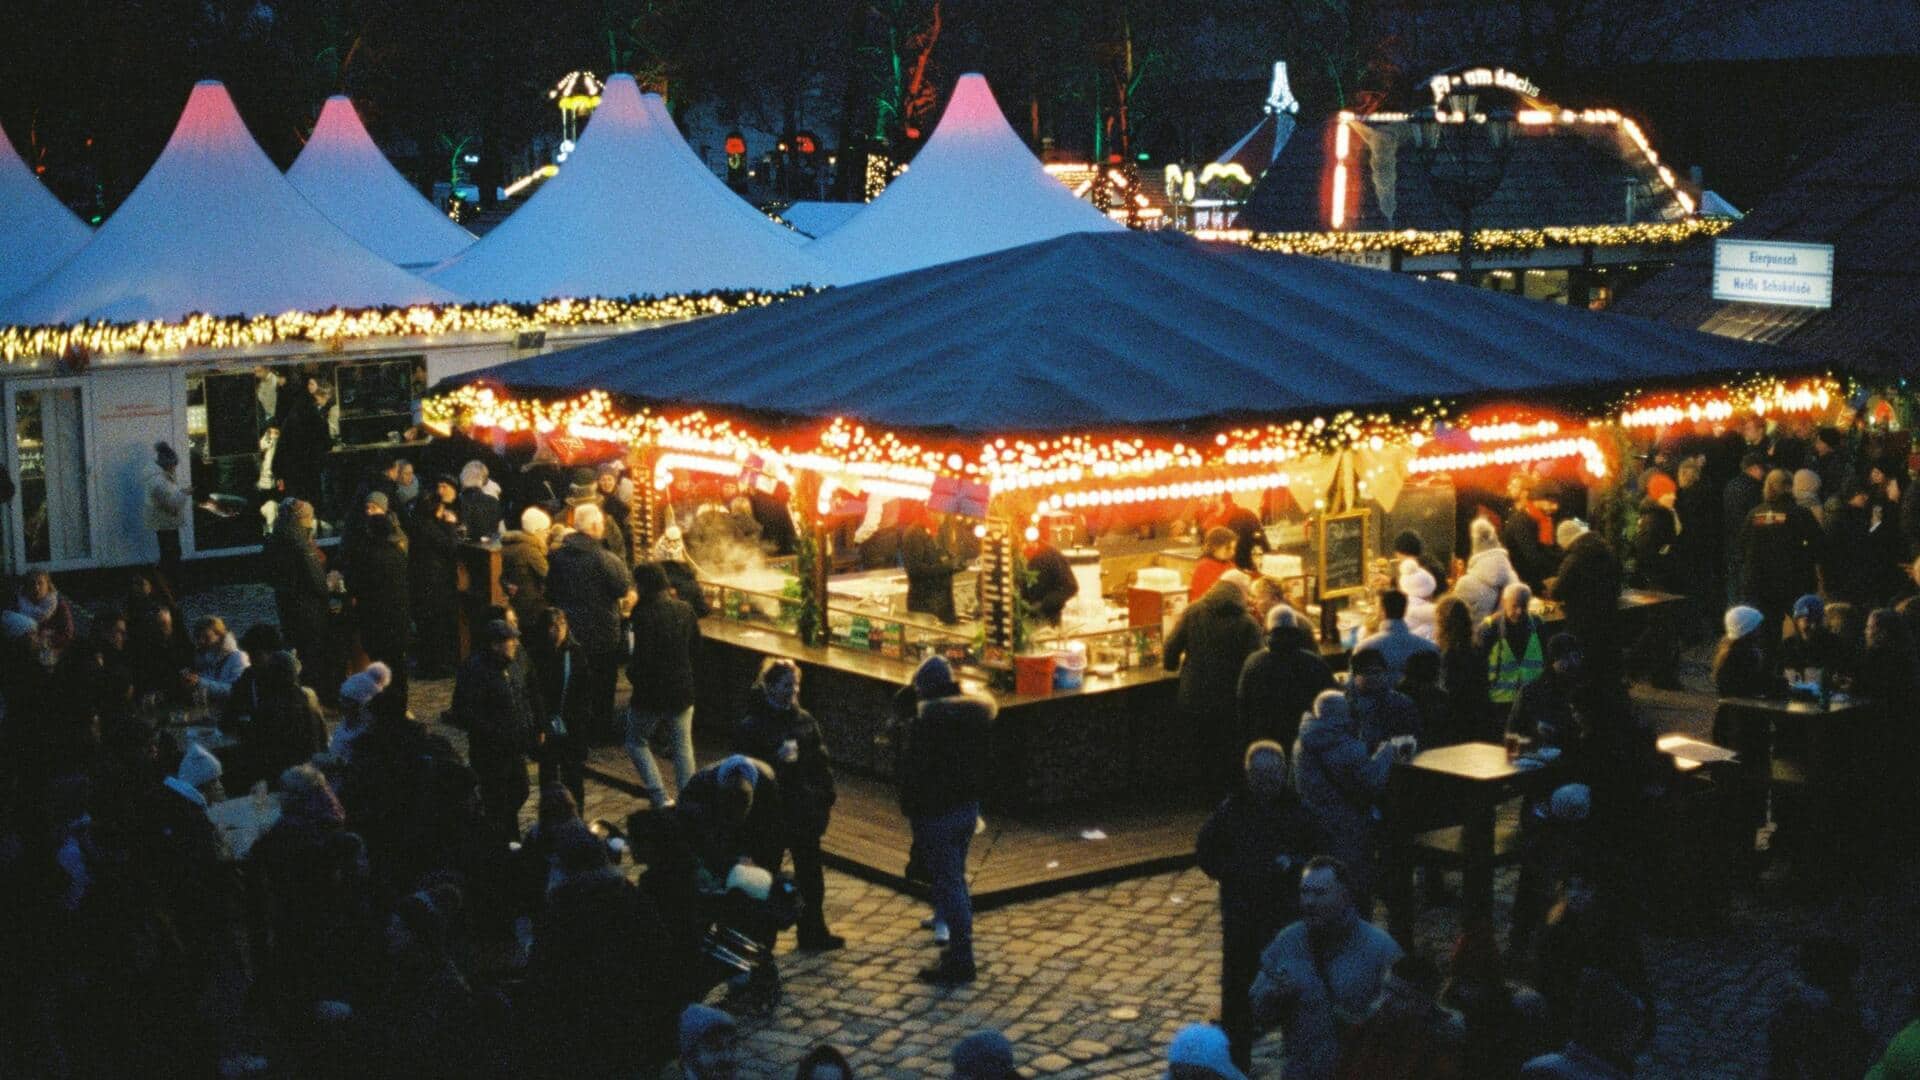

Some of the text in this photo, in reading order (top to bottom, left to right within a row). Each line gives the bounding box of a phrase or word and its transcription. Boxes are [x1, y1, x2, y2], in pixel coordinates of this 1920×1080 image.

[1749, 250, 1798, 267] Eierpunsch
[1733, 277, 1812, 295] Heiße Schokolade
